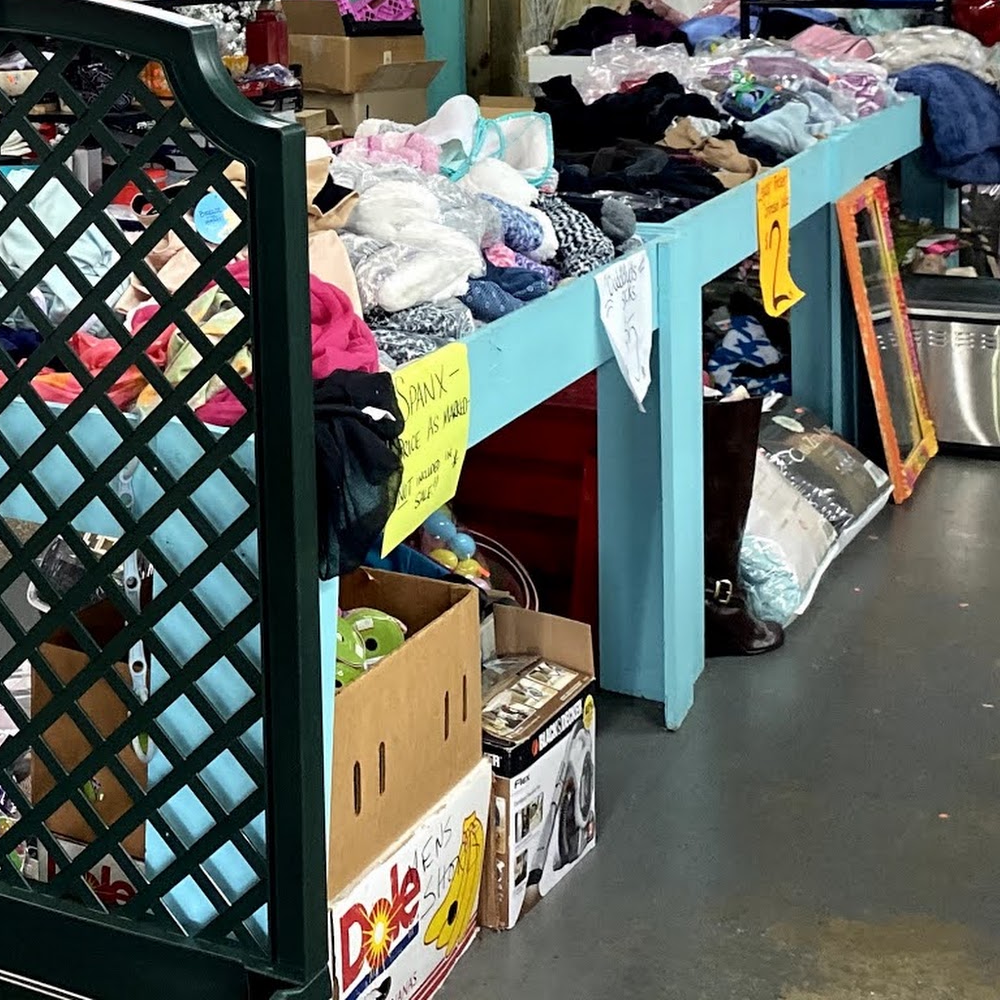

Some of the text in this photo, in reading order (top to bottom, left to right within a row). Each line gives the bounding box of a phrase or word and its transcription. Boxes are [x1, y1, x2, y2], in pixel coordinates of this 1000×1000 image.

[394, 364, 448, 423] SPANX
[427, 415, 440, 441] AS
[513, 773, 530, 790] Flex
[339, 863, 421, 993] Dole
